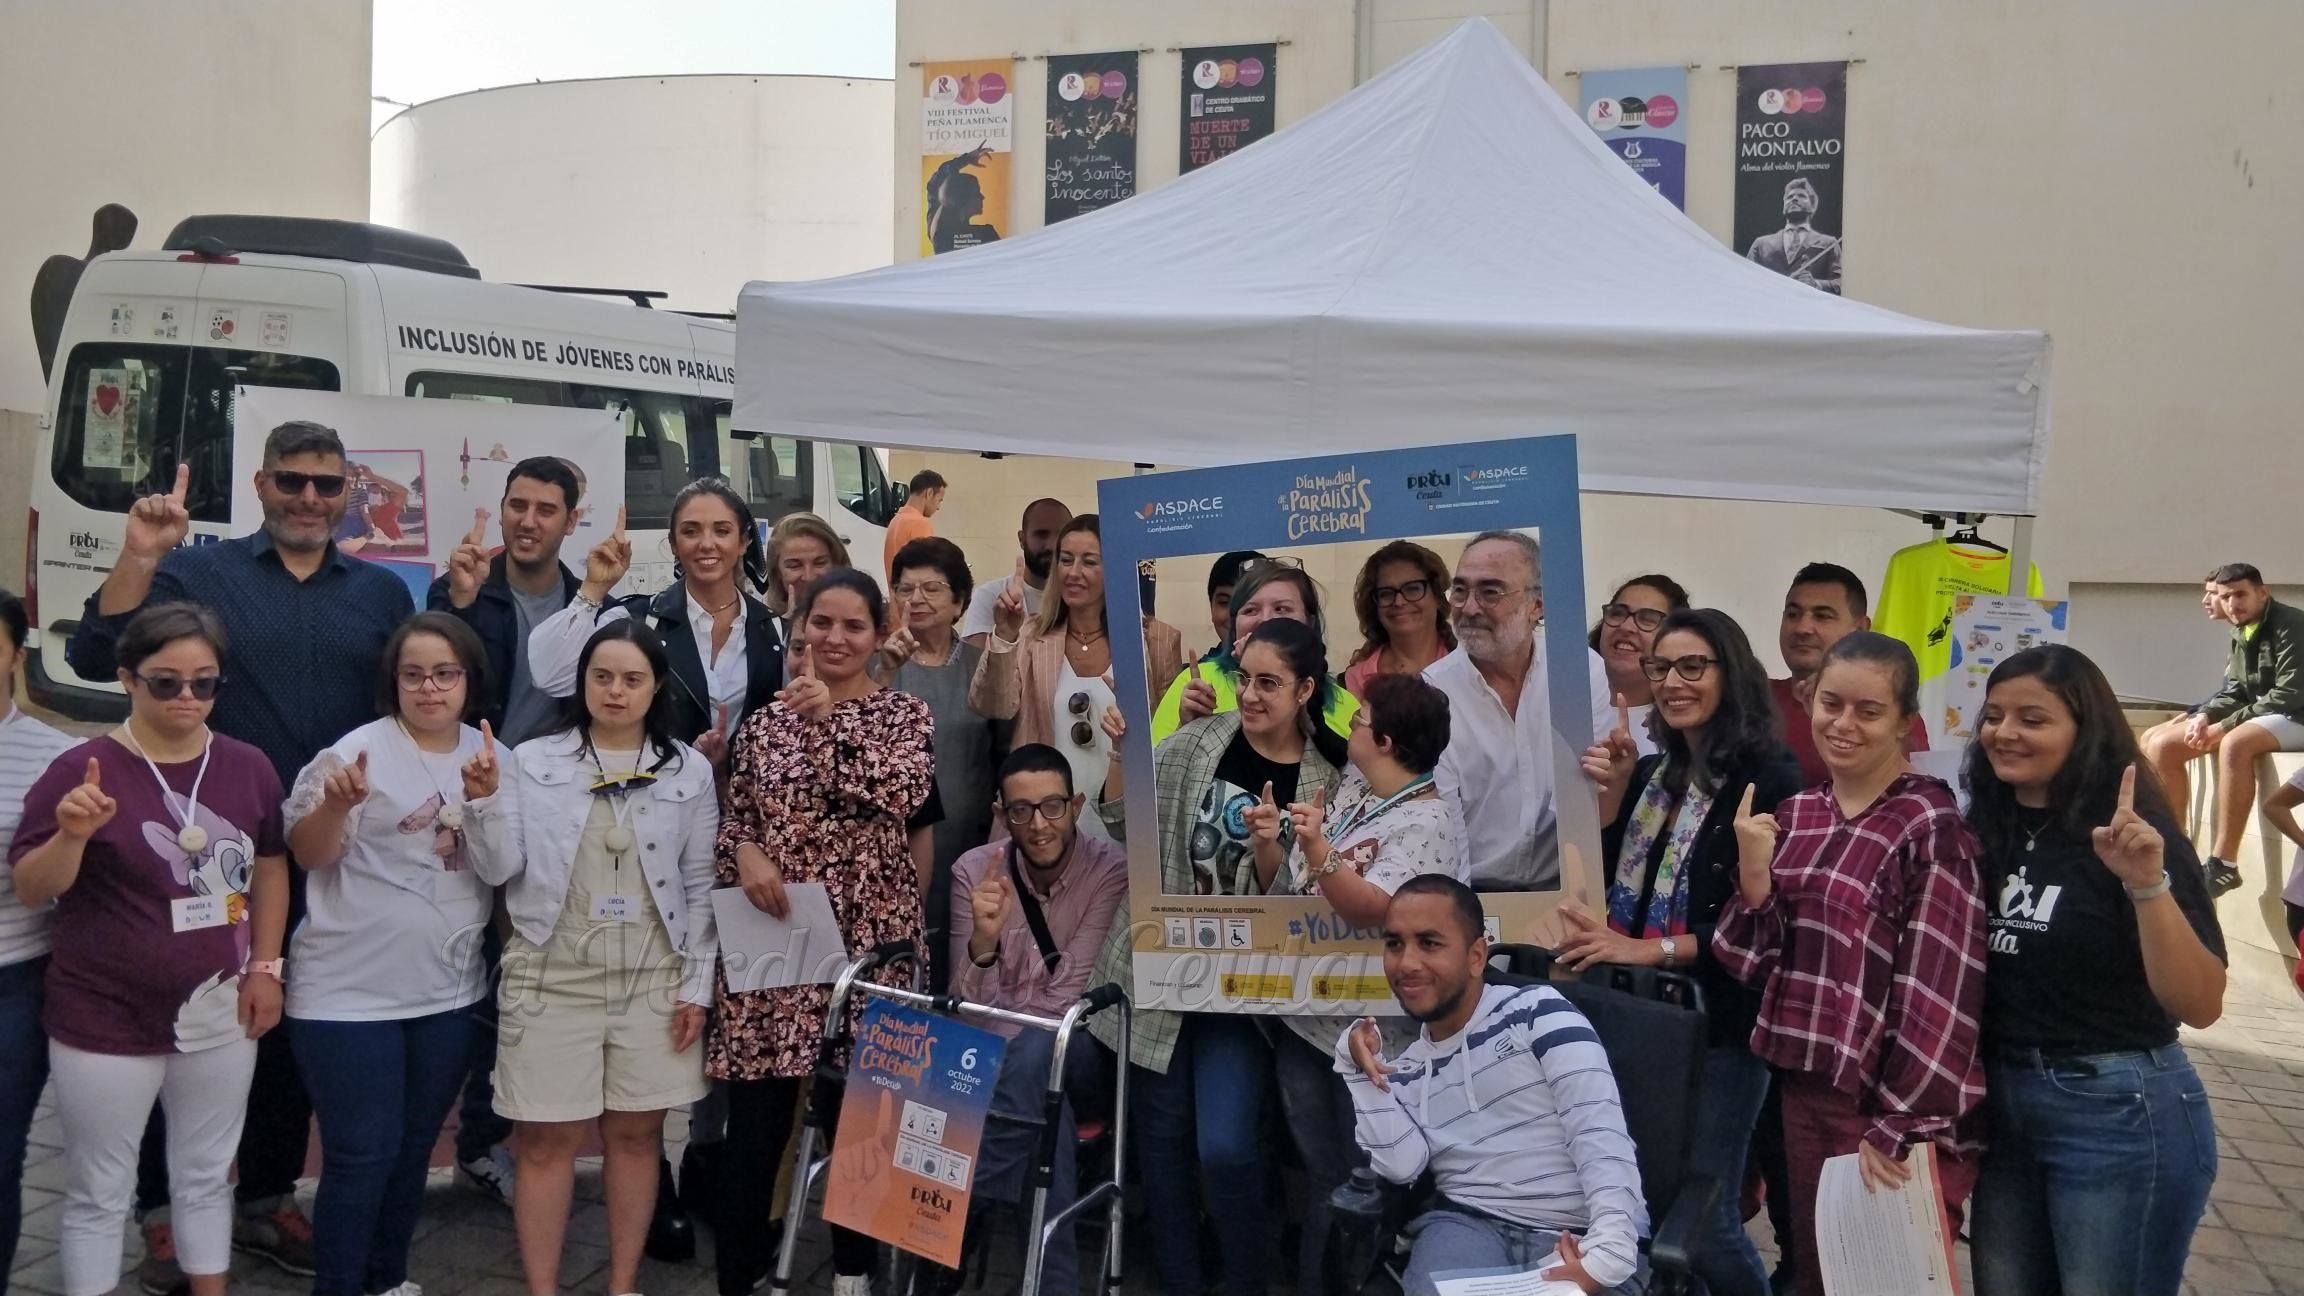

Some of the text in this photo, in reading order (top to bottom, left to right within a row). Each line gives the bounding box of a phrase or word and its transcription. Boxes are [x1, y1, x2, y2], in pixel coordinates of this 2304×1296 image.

[1205, 97, 1230, 105] CENTRO
[928, 107, 991, 117] VIII FESTIVAL
[927, 116, 1008, 127] PEÑA FLAMENCA
[1189, 118, 1250, 134] MUERTE
[927, 127, 1009, 141] TÍO MIGUEL
[1742, 121, 1790, 139] PACO
[1190, 135, 1237, 150] DE UN
[1741, 139, 1841, 158] MONTALVO
[1046, 159, 1133, 184] Los santos
[1740, 163, 1761, 172] Alma
[1762, 161, 1774, 171] del
[1795, 160, 1831, 173] flamenco
[398, 325, 517, 359] INCLUSIÓN
[522, 339, 548, 362] DE
[555, 340, 635, 372] JÓVENES
[638, 354, 673, 376] CON
[1295, 464, 1356, 490] Día Mundial
[1478, 465, 1528, 479] ASPACE
[1155, 496, 1223, 516] ASPACE
[1288, 507, 1365, 540] Cerebral
[1203, 906, 1233, 914] PARÁLISIS
[1233, 906, 1266, 914] CEREBRAL
[2005, 919, 2049, 932] INCLUSIVO
[879, 1013, 894, 1029] Día
[961, 1047, 978, 1070] 6
[947, 1069, 982, 1086] octubre
[950, 1080, 973, 1095] 2022
